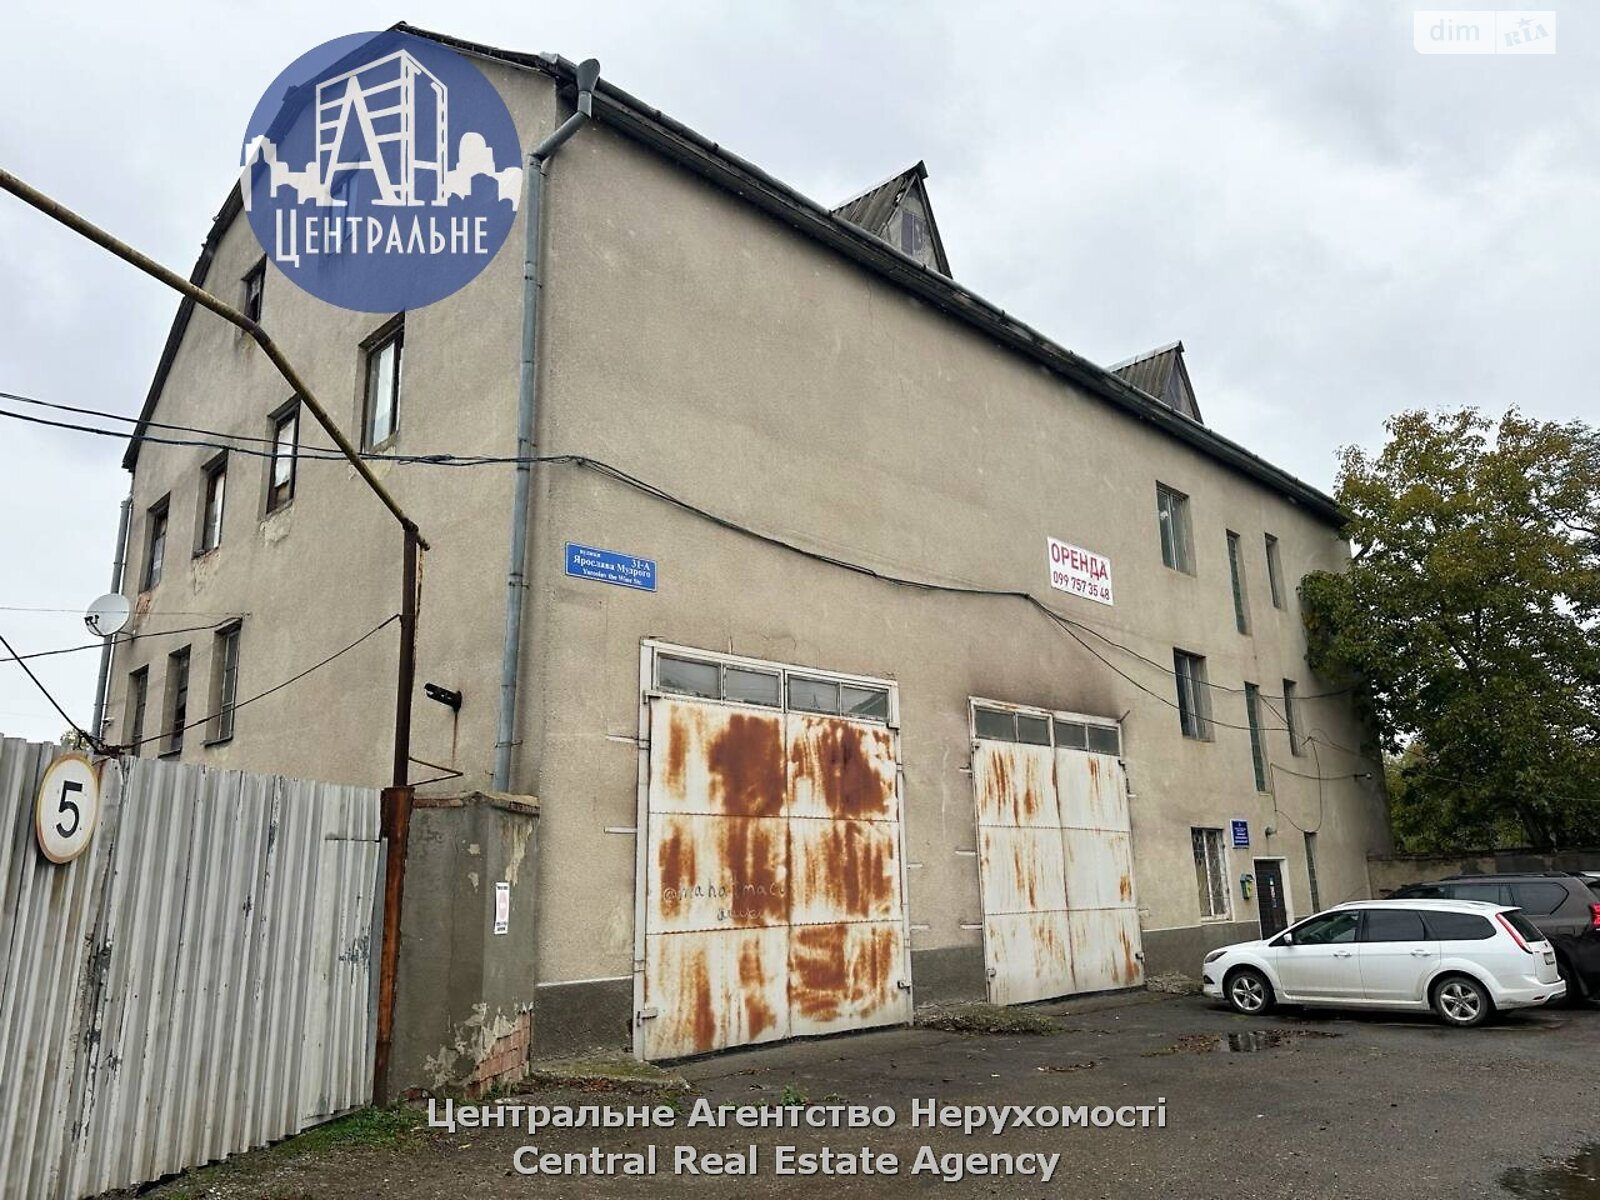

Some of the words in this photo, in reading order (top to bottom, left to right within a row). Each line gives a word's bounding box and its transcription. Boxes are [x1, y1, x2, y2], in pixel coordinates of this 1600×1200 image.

[573, 554, 615, 571] Ярослава
[616, 562, 651, 579] Мудрого
[1051, 542, 1109, 581] ОРЕНДА
[1053, 570, 1070, 587] 099
[1071, 576, 1087, 593] 757
[1088, 582, 1099, 597] 35
[1099, 586, 1110, 601] 48
[56, 780, 83, 838] 5
